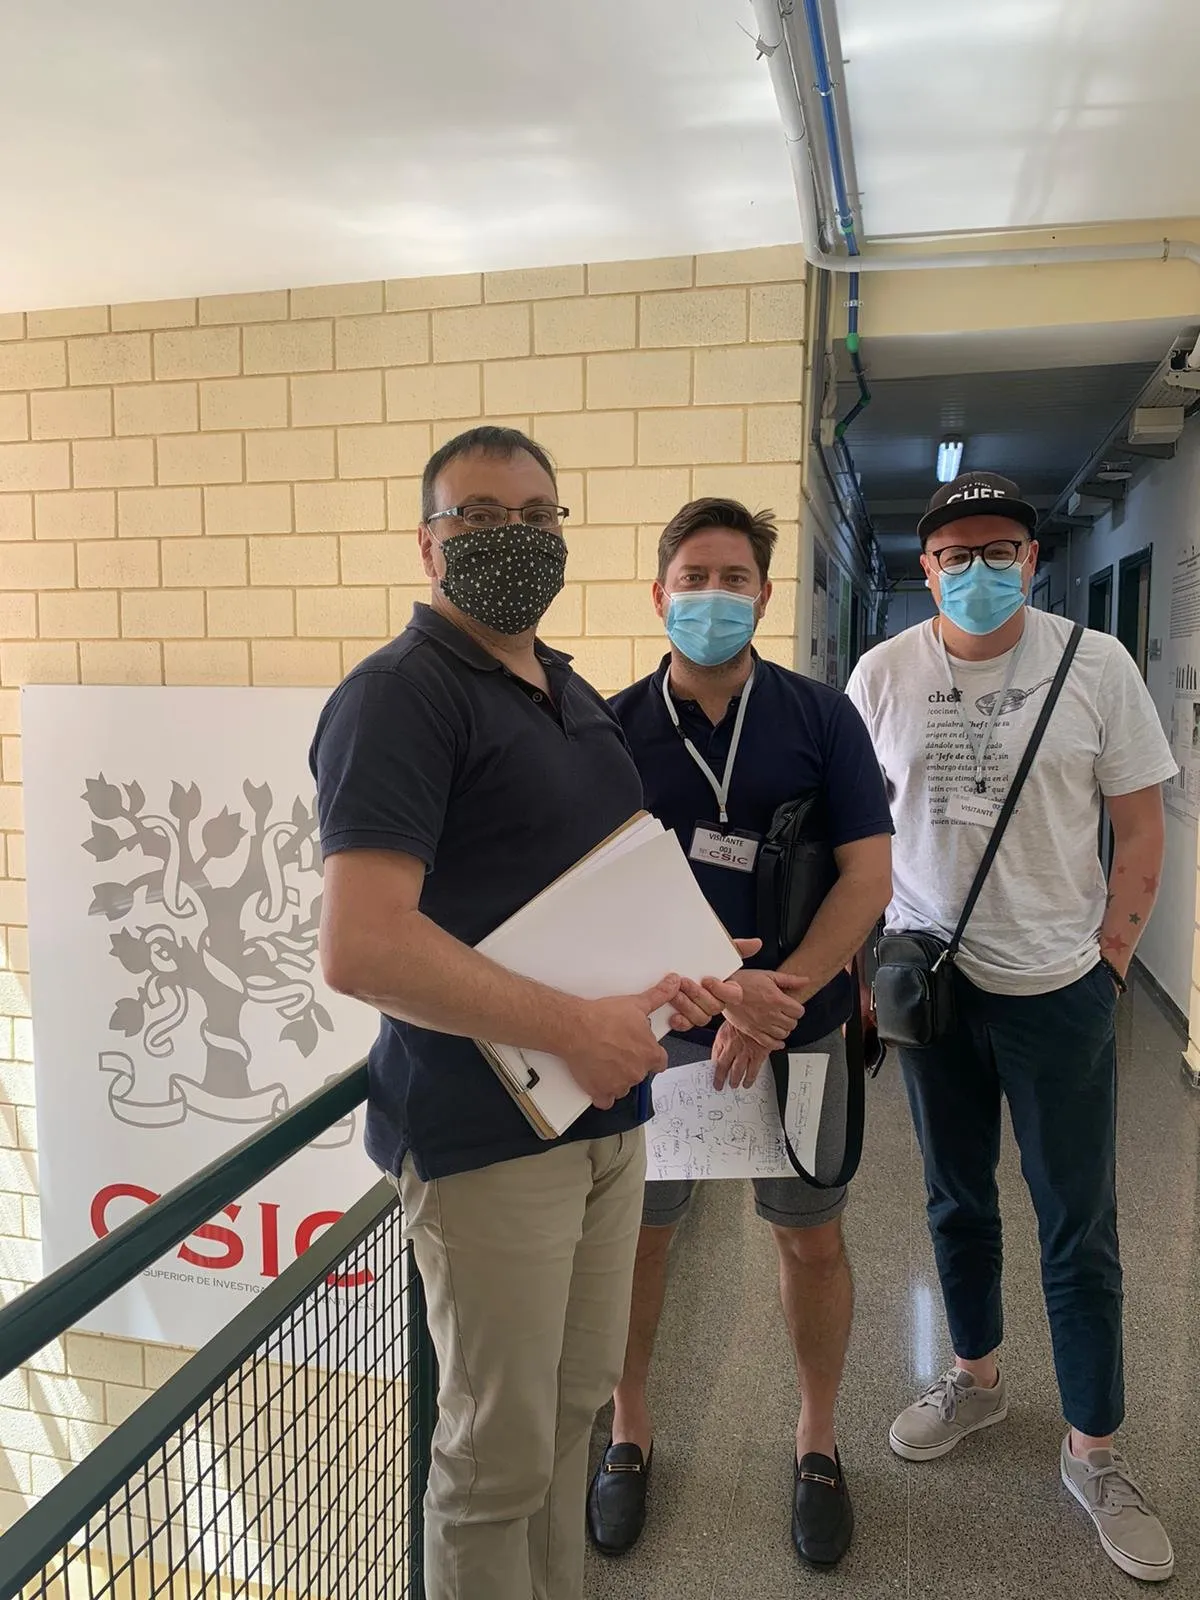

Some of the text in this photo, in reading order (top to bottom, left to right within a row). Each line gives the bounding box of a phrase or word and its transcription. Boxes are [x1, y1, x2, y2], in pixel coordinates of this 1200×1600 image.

[928, 690, 963, 703] chef
[927, 763, 956, 772] embargo
[961, 804, 994, 818] VISITANTE
[709, 833, 745, 847] VISITANTE
[709, 850, 748, 865] CSIC
[143, 1268, 194, 1284] SUPERIOR
[196, 1276, 211, 1286] DE
